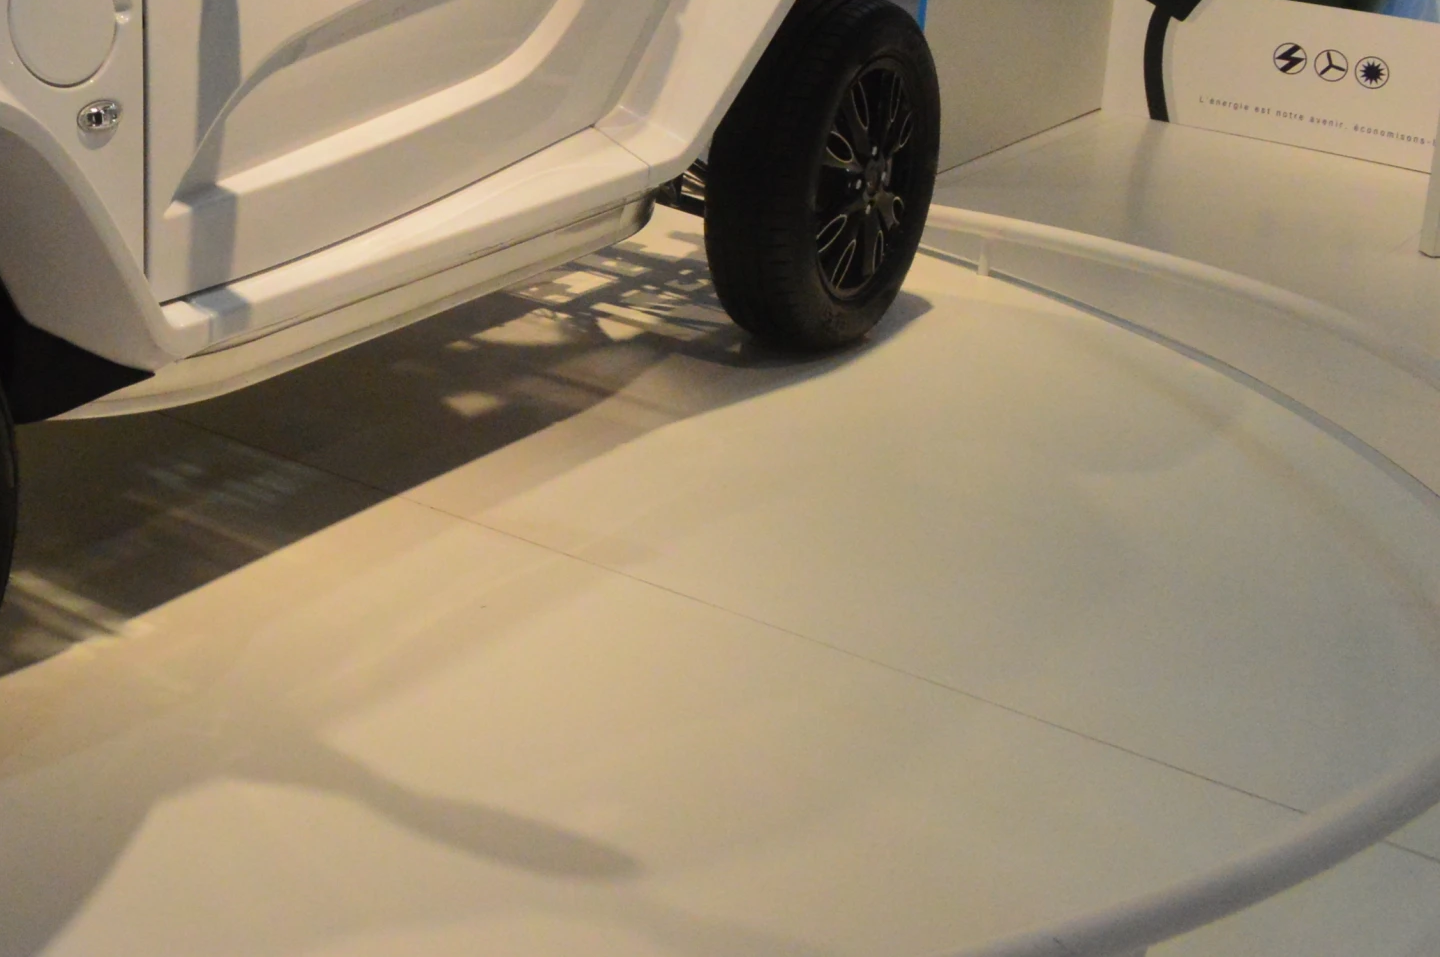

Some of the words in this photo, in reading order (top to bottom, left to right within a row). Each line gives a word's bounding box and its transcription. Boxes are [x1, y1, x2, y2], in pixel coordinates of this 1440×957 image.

[1199, 95, 1249, 111] L'énergie
[1254, 105, 1271, 115] est
[1276, 109, 1304, 121] notre
